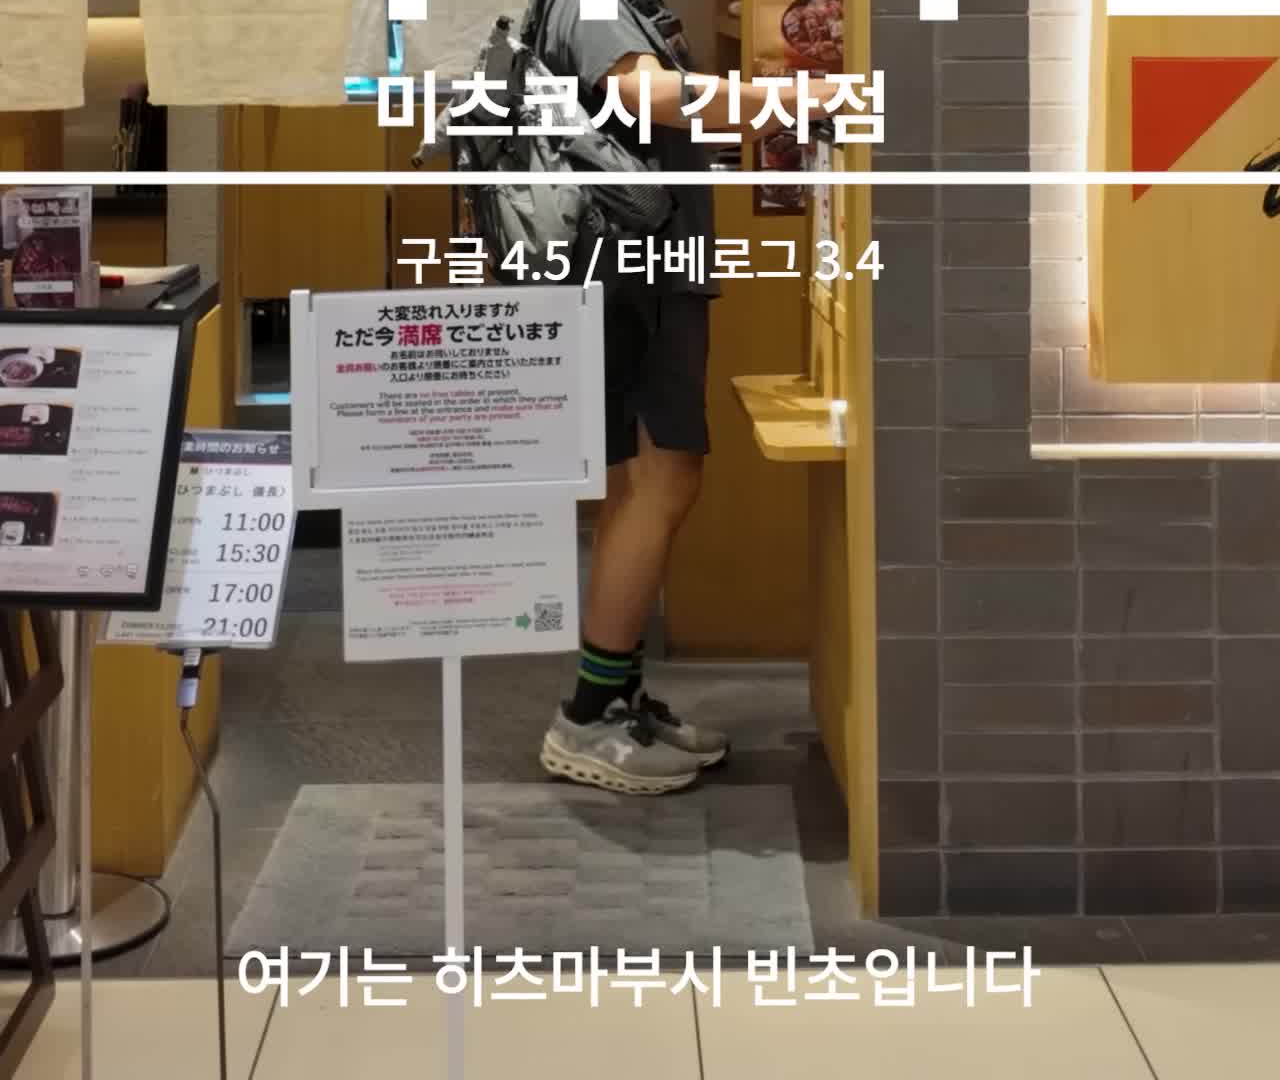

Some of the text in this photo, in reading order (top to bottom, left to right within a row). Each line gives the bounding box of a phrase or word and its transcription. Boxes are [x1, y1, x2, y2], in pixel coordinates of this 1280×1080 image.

[378, 302, 520, 321] 大変恐れ入りますが
[335, 321, 563, 347] ただ今満席でございます
[221, 512, 285, 531] 11:00
[215, 543, 280, 563] 15:30
[208, 583, 273, 603] 17:00
[200, 617, 267, 637] 21:00
